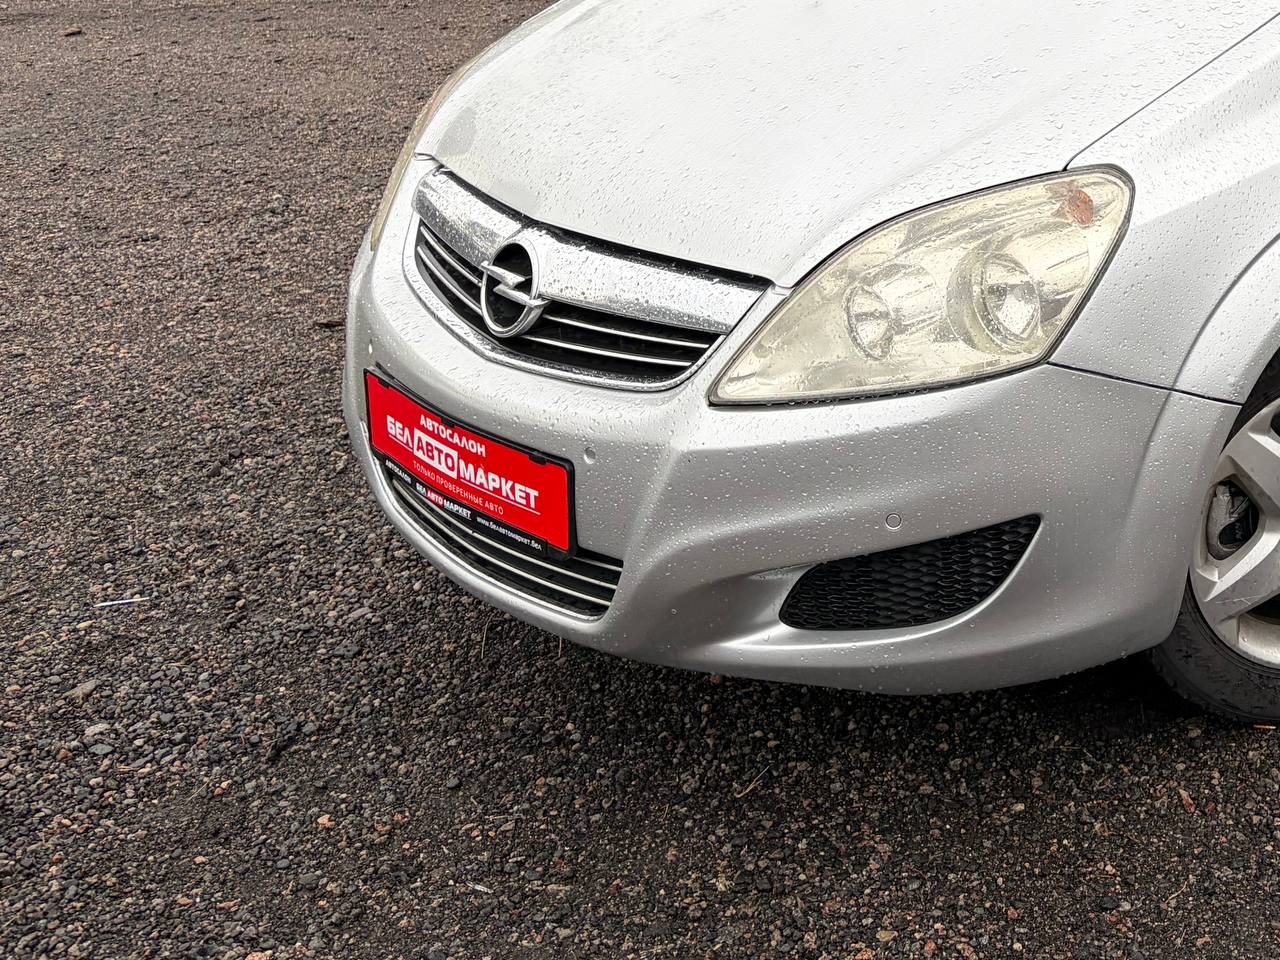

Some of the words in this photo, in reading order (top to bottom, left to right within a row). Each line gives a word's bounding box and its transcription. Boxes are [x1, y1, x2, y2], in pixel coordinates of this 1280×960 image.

[420, 414, 486, 457] АВТОСАЛОН
[387, 415, 413, 448] БЕЛ
[416, 434, 456, 473] АВТО
[459, 459, 539, 509] МАРКЕТ
[413, 461, 435, 480] ТОЛЬКО
[436, 474, 483, 506] ПРОВЕРЕННЫЕ
[484, 500, 504, 515] АВТО
[427, 490, 443, 505] АВТО
[443, 498, 471, 518] МАРКЕТ
